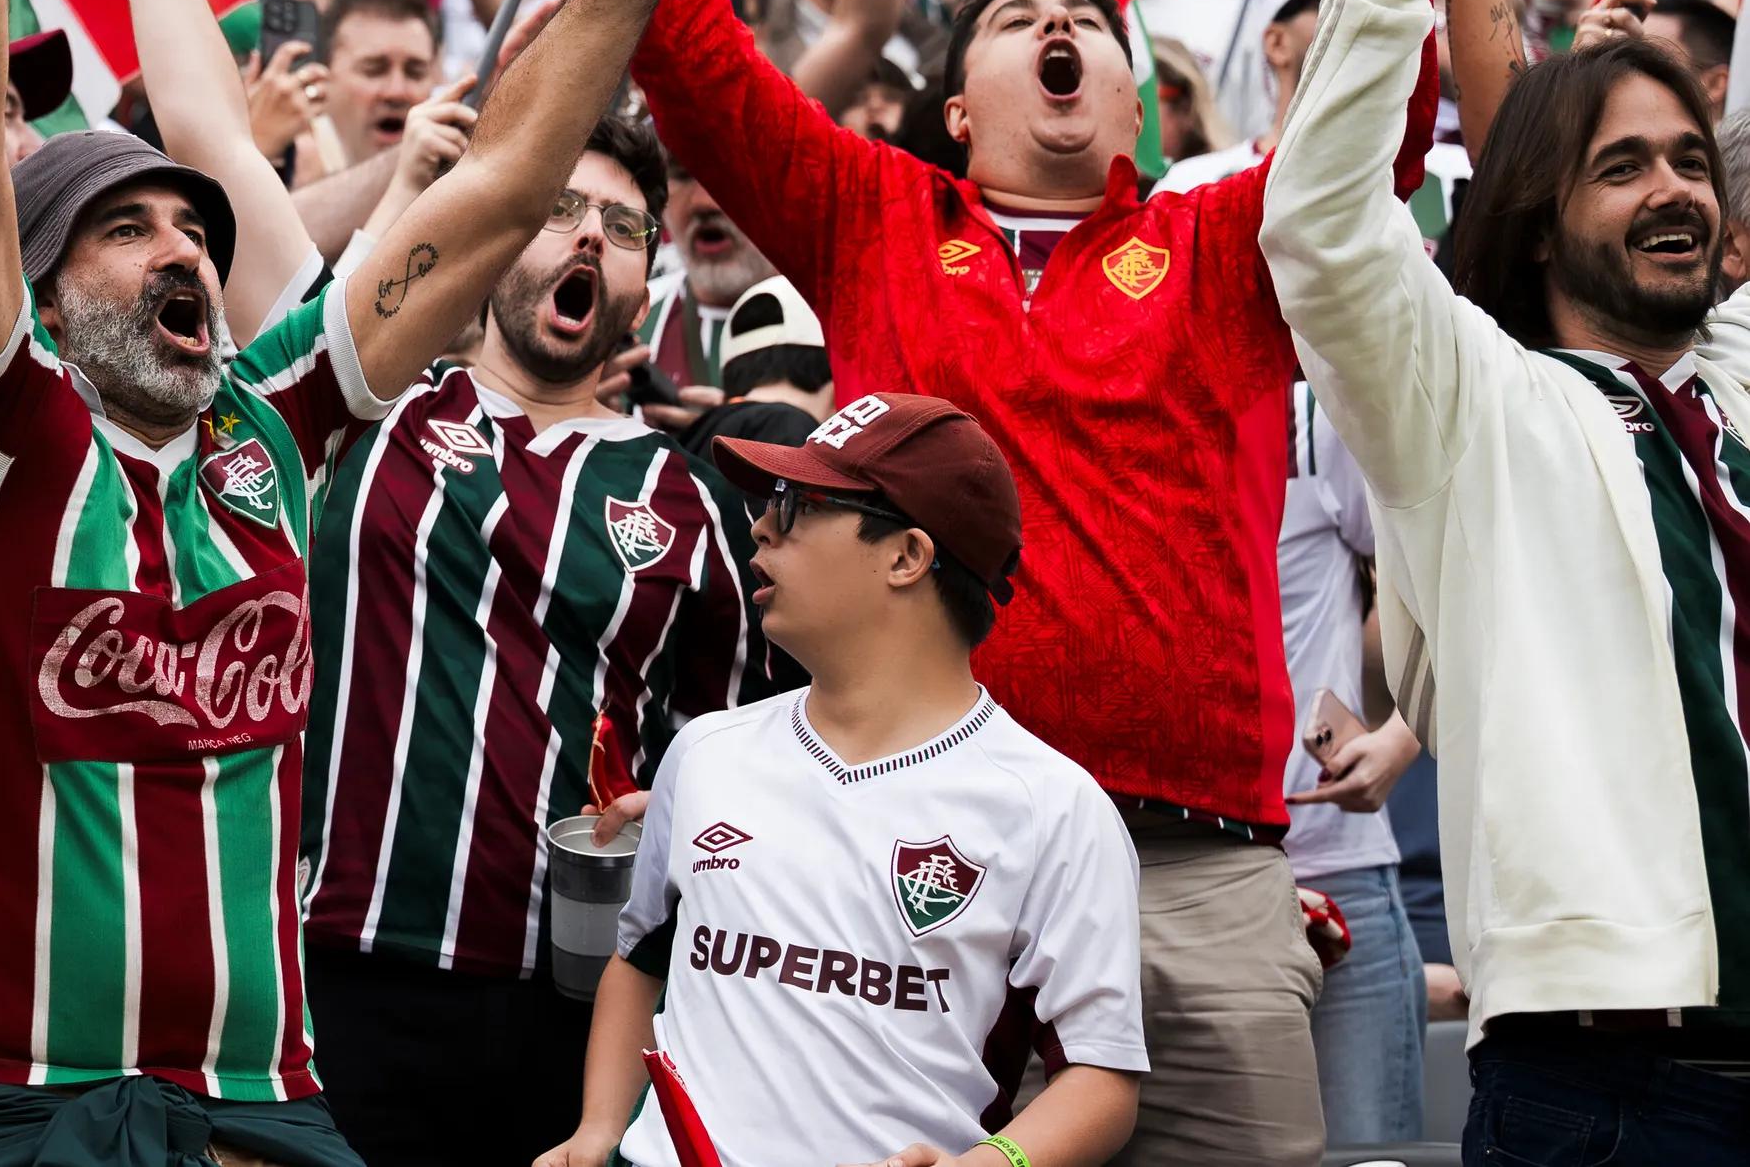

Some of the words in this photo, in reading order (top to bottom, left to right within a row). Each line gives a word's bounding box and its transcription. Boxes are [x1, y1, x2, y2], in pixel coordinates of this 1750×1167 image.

[188, 738, 226, 751] MARCA
[692, 855, 740, 874] umbro
[689, 925, 951, 1013] SUPERBET
[986, 1137, 1018, 1157] WORL
